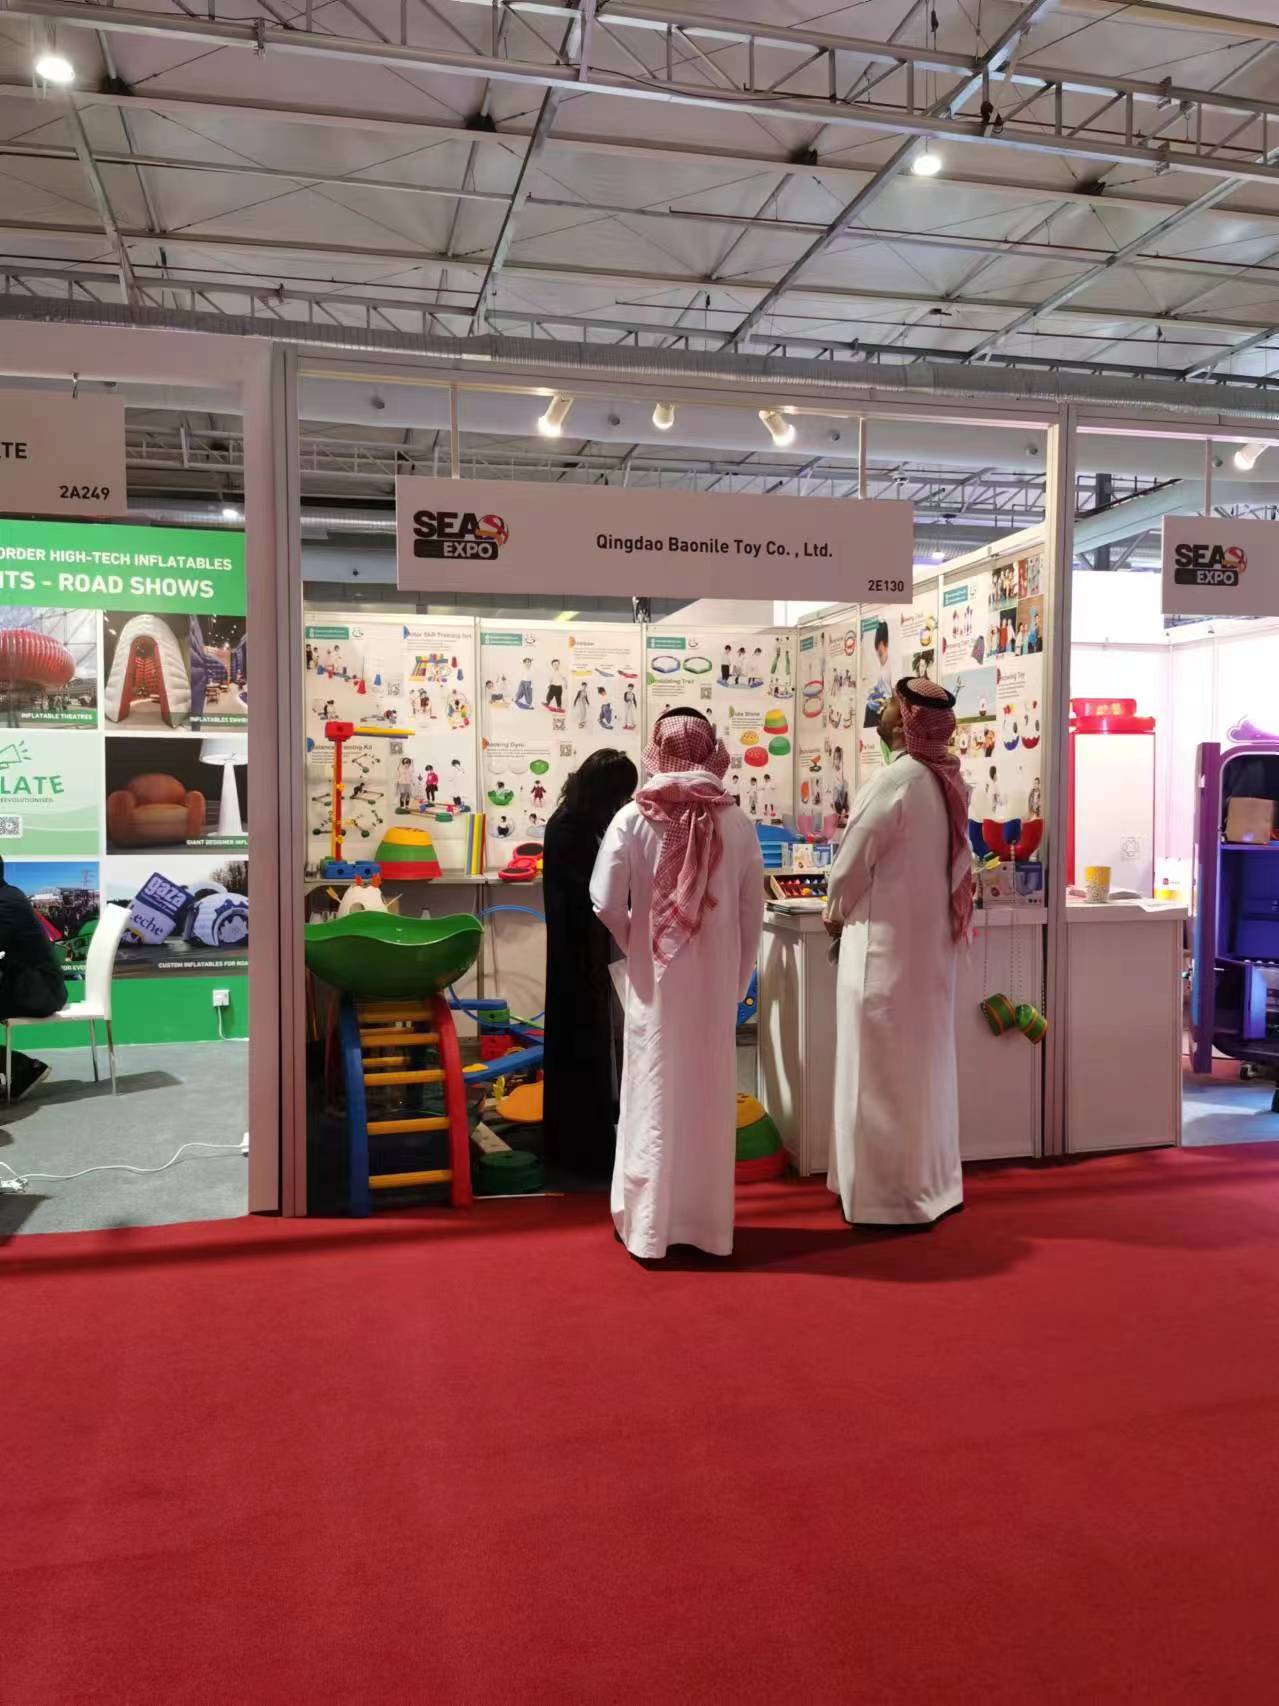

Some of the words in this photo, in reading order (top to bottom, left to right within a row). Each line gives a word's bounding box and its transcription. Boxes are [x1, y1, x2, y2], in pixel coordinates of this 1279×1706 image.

[0, 441, 28, 460] TE
[59, 485, 110, 500] 2A249
[413, 510, 479, 539] SEA
[443, 541, 493, 558] EXPO
[596, 533, 664, 554] Qingdao
[668, 536, 729, 553] Baonile
[734, 539, 762, 558] Toy
[804, 541, 833, 558] Ltd.
[50, 549, 131, 565] HIGH-TECH
[134, 553, 233, 571] INFLATABLES
[1174, 543, 1226, 569] SEA
[59, 572, 124, 594] ROAD
[130, 576, 214, 599] SHOWS
[868, 579, 905, 592] 2E130
[1197, 570, 1235, 585] EXPO
[144, 876, 187, 908] gaza
[184, 960, 223, 968] INFLATABLES
